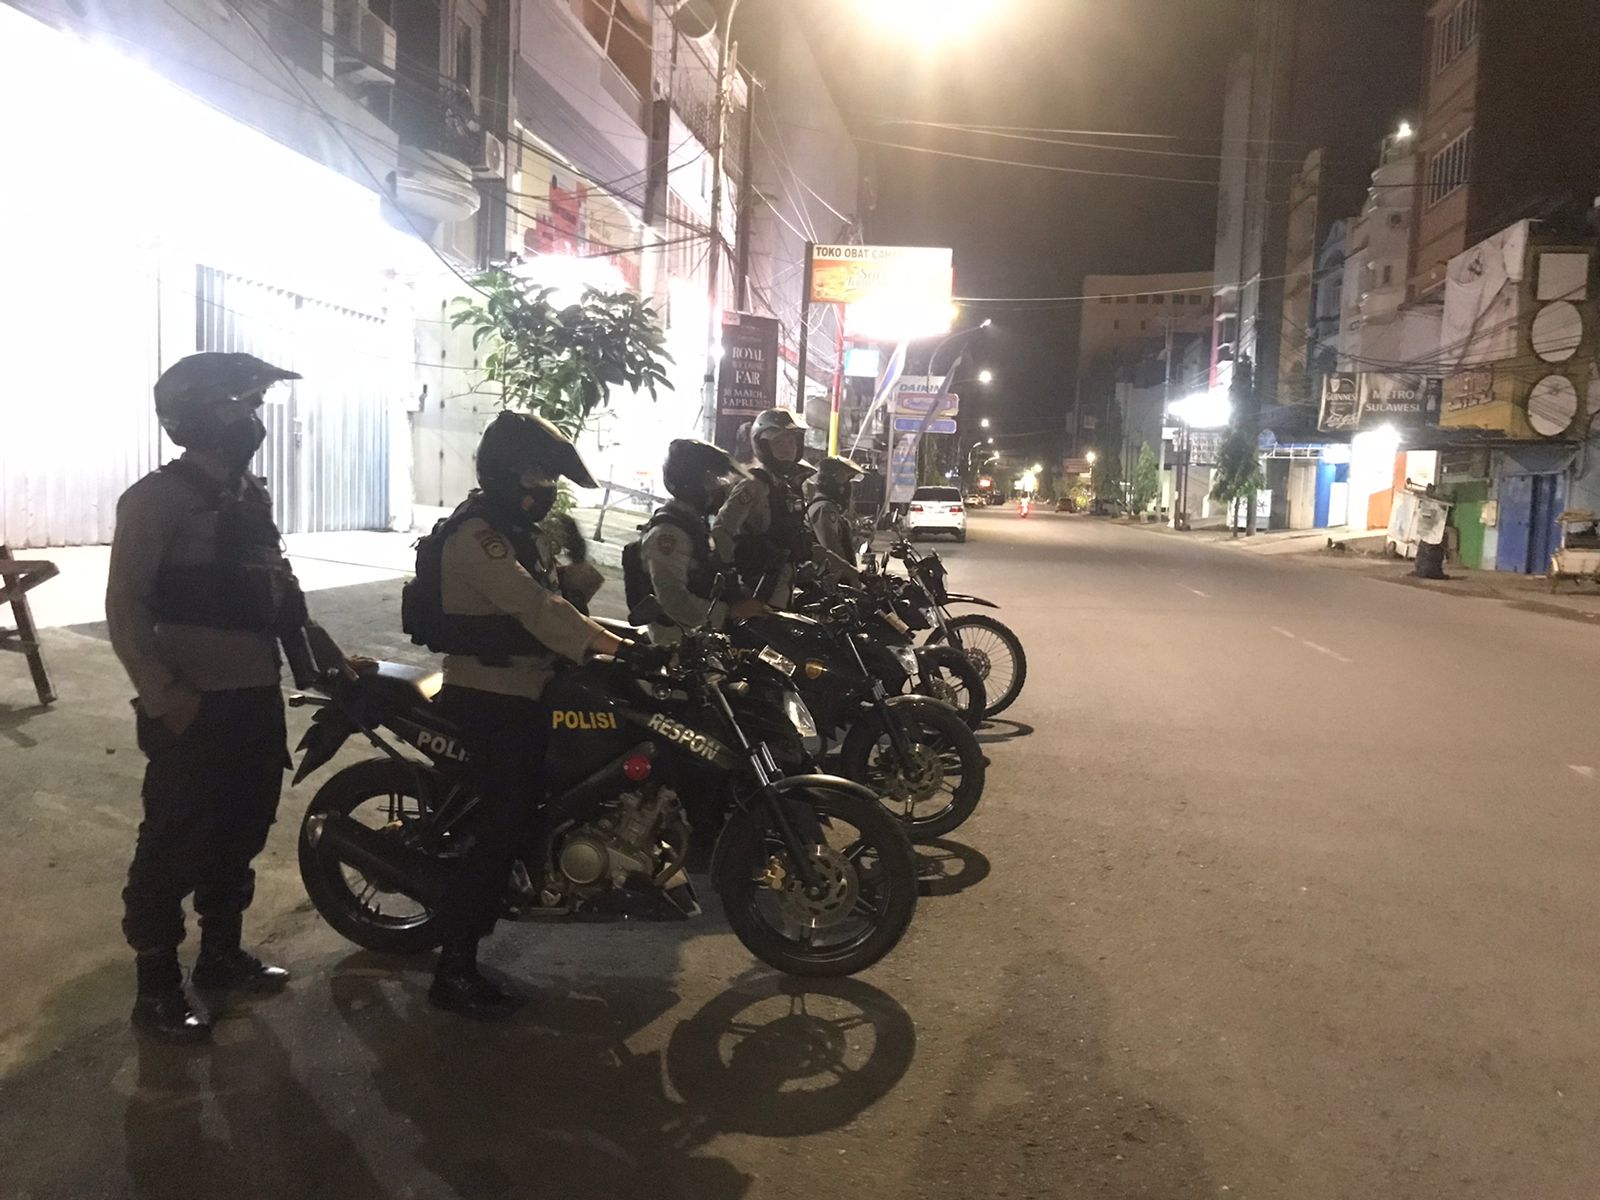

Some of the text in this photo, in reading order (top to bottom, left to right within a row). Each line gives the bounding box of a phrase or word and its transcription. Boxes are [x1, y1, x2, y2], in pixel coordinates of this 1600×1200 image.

[815, 246, 842, 258] TOKO
[844, 248, 870, 259] OBAT
[732, 346, 765, 362] ROYAL
[735, 370, 761, 386] FAIR
[899, 383, 942, 393] DAIKIN
[1372, 389, 1416, 400] METRO
[1365, 402, 1421, 412] SULAWESI
[551, 710, 617, 730] POLISI
[647, 712, 721, 762] RESPON
[416, 730, 471, 763] POLI
